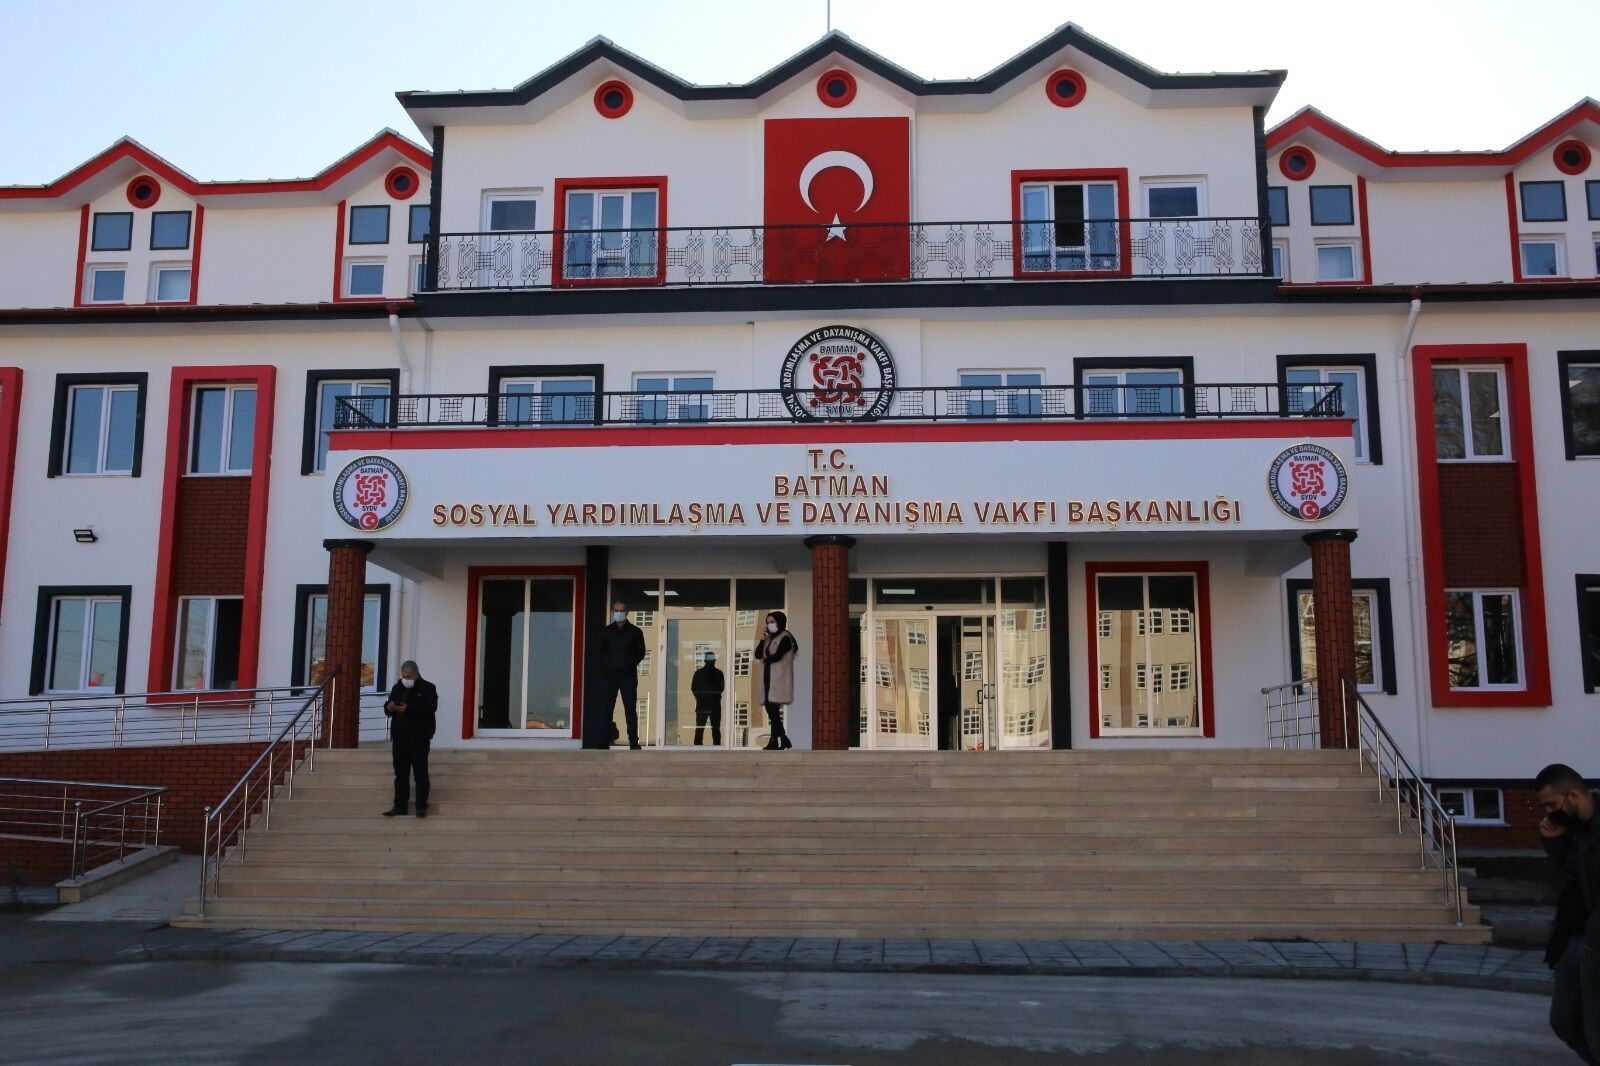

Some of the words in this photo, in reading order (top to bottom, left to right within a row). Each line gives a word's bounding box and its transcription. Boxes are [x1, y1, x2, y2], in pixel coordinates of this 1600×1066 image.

[783, 339, 811, 390] ARDIMLAŞMA
[810, 331, 822, 342] VE
[823, 328, 871, 347] DAYANIŞMA
[870, 341, 888, 366] VAKFI
[819, 345, 858, 354] BATMAN
[826, 405, 852, 414] SYDV
[808, 448, 855, 471] T.C.
[1290, 446, 1299, 454] VE
[774, 474, 889, 498] BATMAN
[432, 503, 536, 526] SOSYAL
[547, 502, 746, 531] YARDIMLAŞMA
[756, 501, 791, 524] VE
[802, 501, 964, 530] DAYANIŞMA
[973, 500, 1057, 525] VAKFI
[1067, 494, 1242, 529] BAŞKANLIĞI
